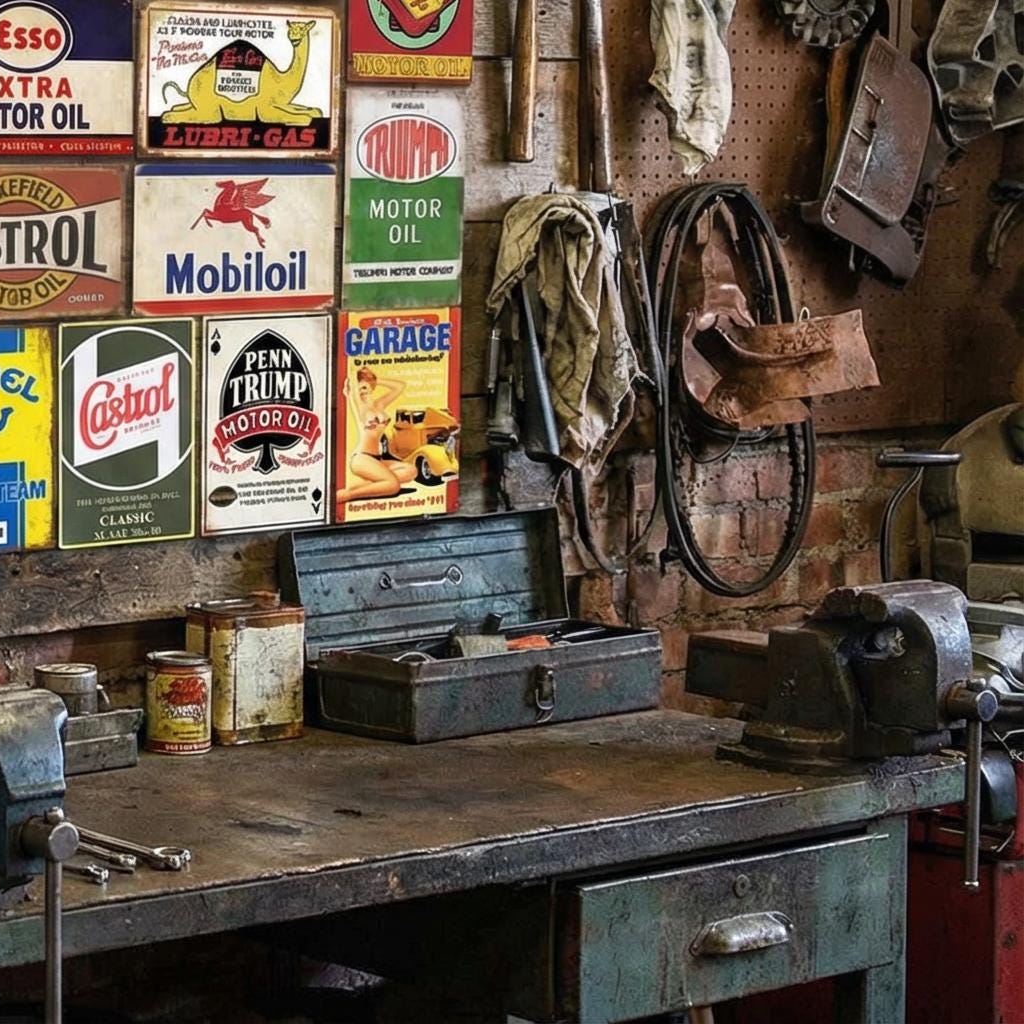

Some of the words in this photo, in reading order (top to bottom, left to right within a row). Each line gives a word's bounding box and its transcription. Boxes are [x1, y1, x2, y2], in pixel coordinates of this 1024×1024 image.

[52, 103, 90, 130] OIL
[370, 199, 441, 219] MOTOR
[389, 225, 421, 244] OIL
[34, 273, 67, 298] OIL
[165, 249, 307, 295] Mobiloil
[346, 323, 452, 356] GARAGE
[245, 349, 292, 372] PENN
[230, 371, 308, 408] TRUMP
[80, 362, 175, 450] Castrol
[221, 410, 282, 439] MOTOR
[100, 512, 155, 526] CLASSIC
